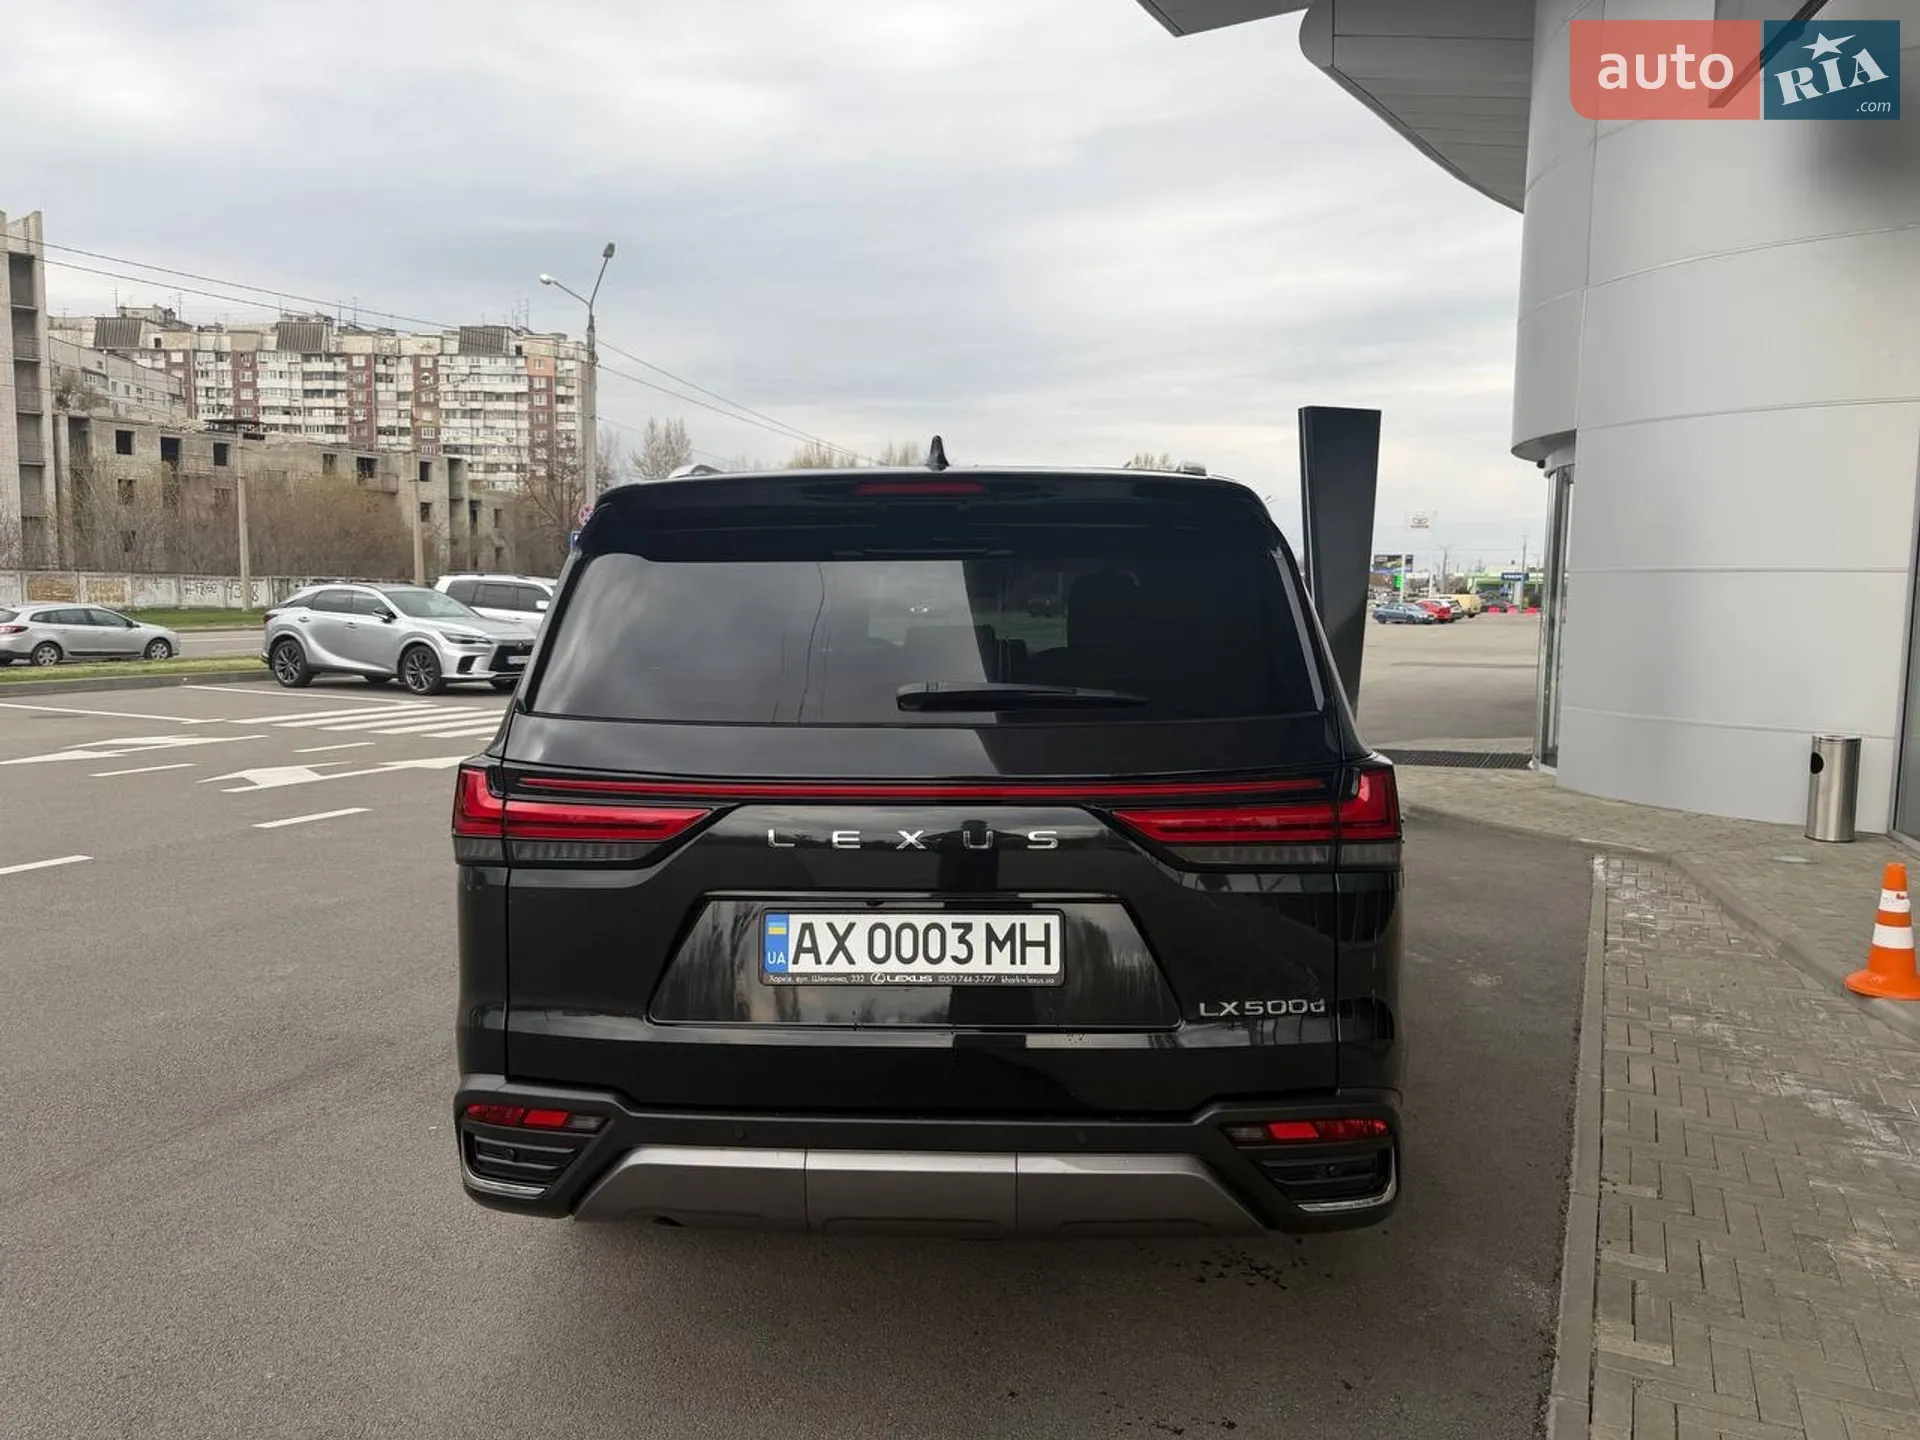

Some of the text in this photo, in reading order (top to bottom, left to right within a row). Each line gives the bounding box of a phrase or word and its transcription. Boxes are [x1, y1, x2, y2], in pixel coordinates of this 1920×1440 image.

[767, 829, 1059, 850] LEXUS
[792, 922, 1052, 965] AX 0003 MH
[767, 952, 786, 965] UA
[886, 975, 933, 983] LEXUS
